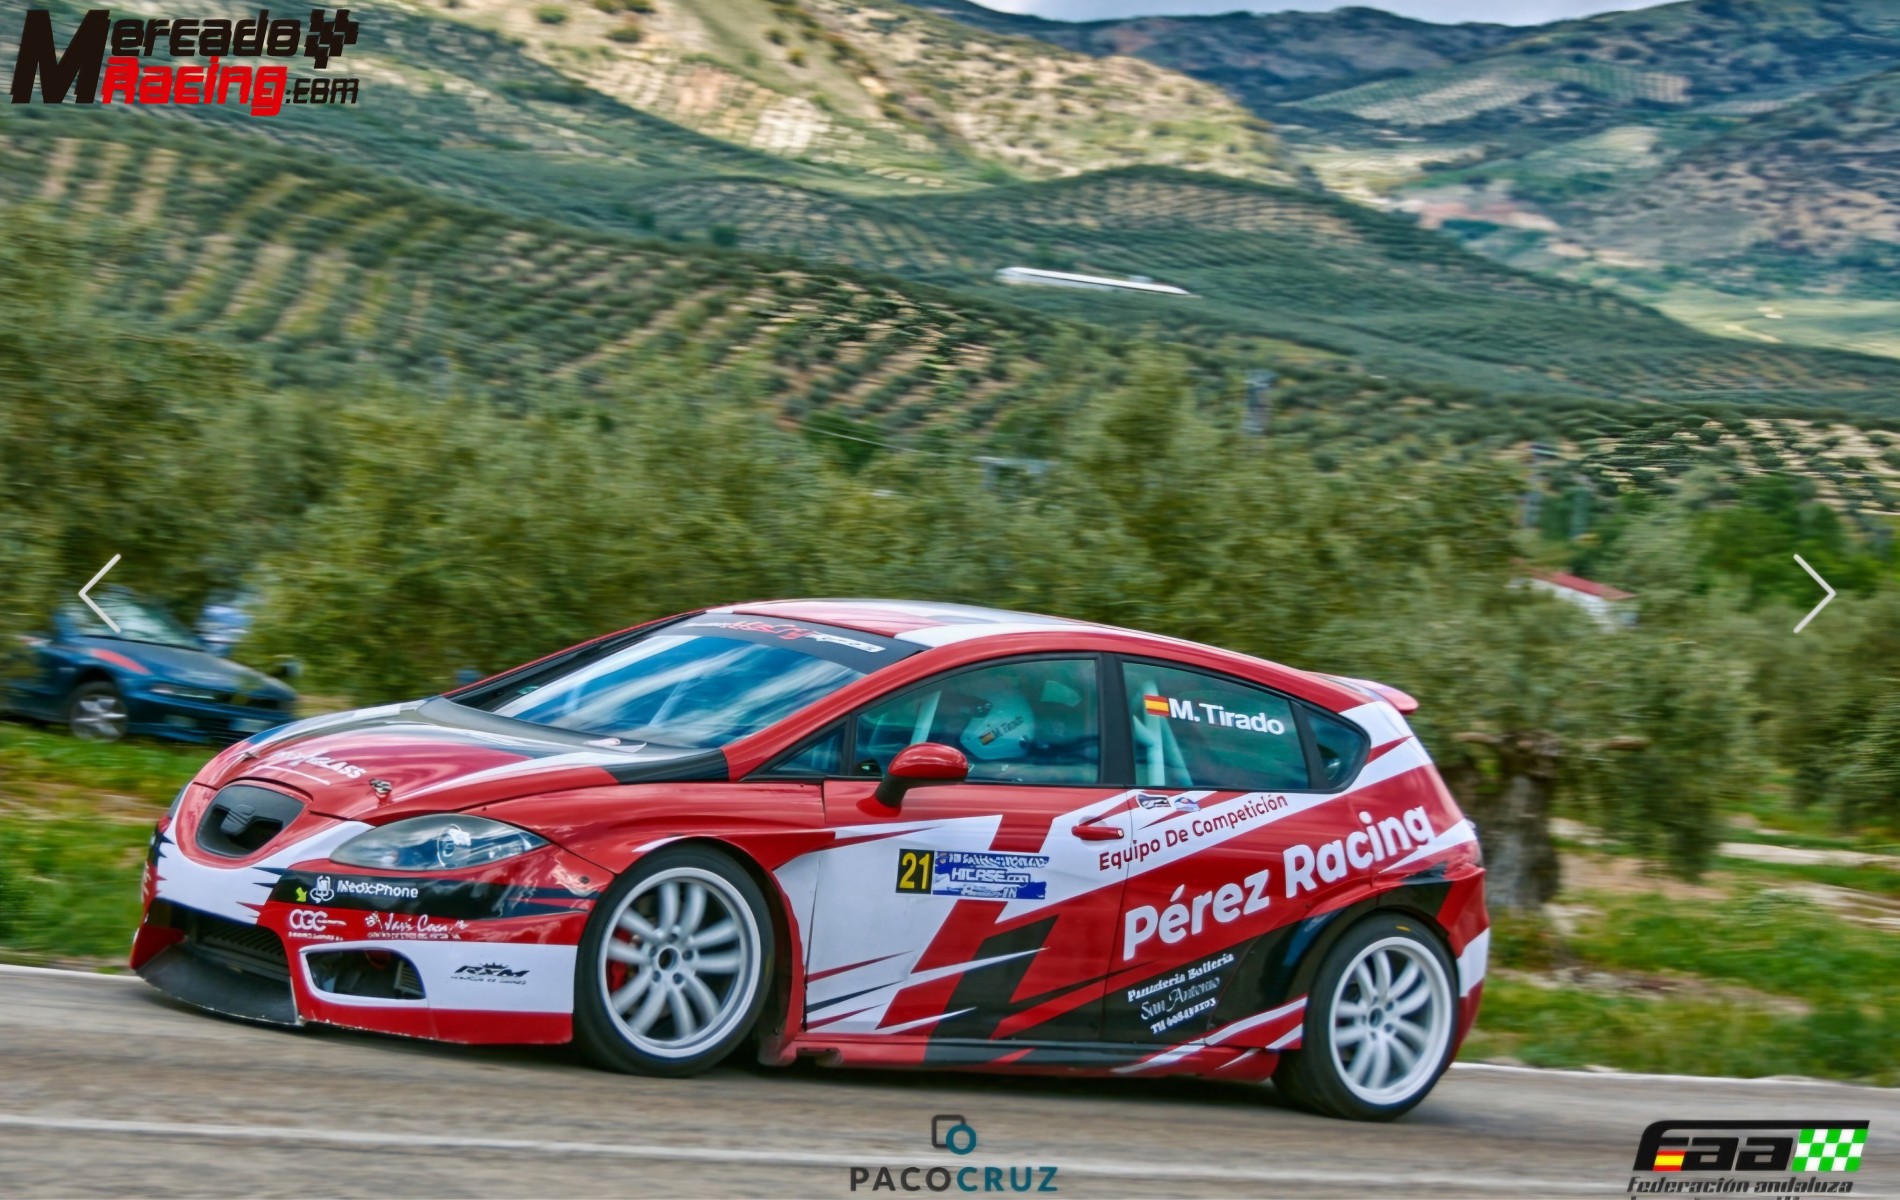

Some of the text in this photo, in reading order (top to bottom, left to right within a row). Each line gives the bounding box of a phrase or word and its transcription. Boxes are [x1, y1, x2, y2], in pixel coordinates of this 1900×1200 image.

[1200, 703, 1285, 735] Tirado
[1099, 839, 1161, 871] Equipo
[1165, 828, 1189, 848] De
[1192, 793, 1288, 837] Competición
[899, 852, 931, 890] 21
[1123, 805, 1436, 961] Pérez Racing
